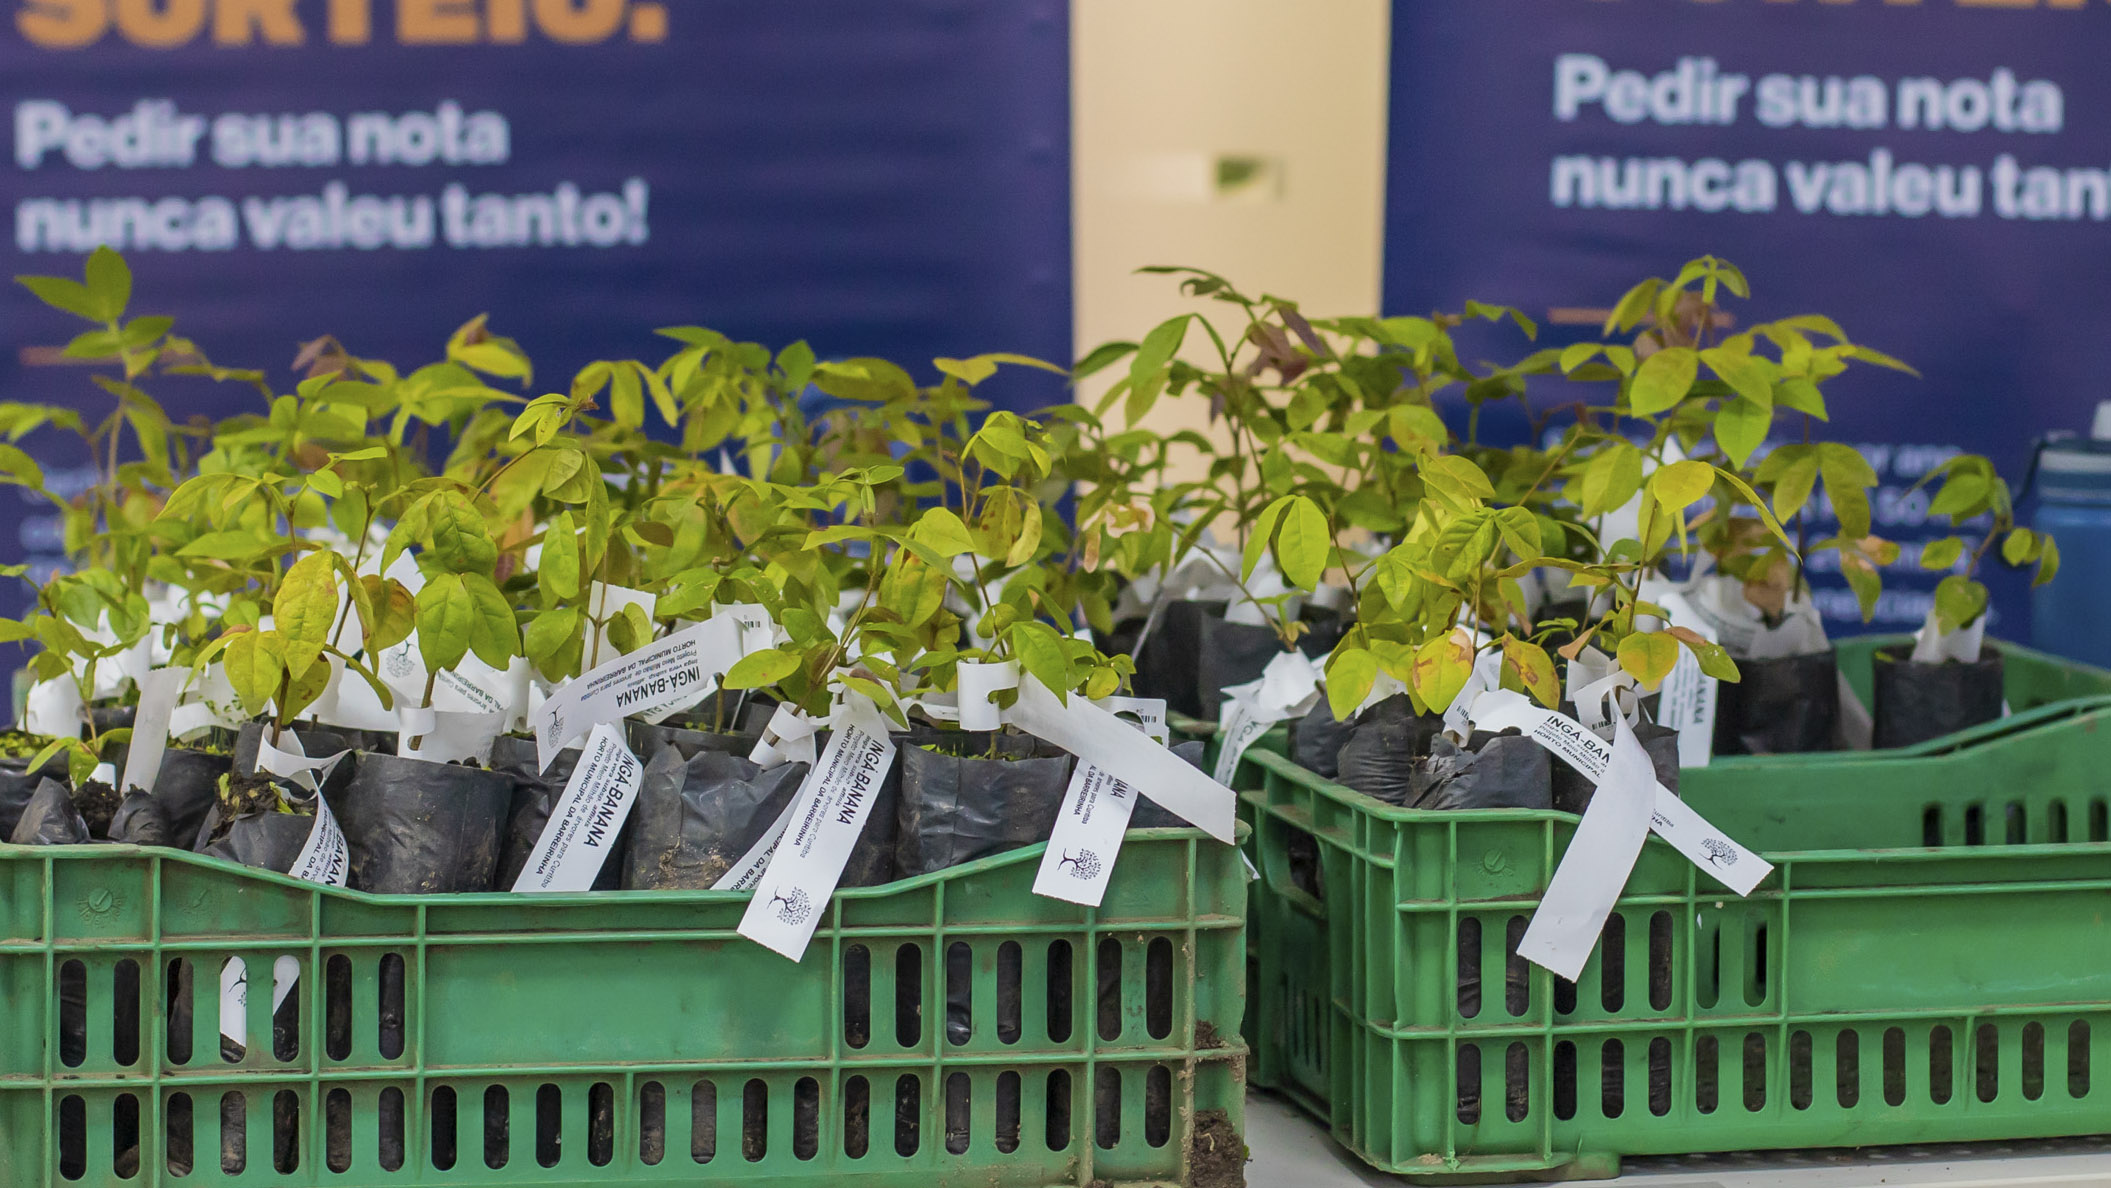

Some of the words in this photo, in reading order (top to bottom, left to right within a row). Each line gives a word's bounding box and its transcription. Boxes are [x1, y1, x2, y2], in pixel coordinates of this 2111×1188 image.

[1554, 53, 1749, 125] Pedir
[1756, 74, 1888, 130] sua
[1896, 67, 2064, 134] nota
[14, 99, 206, 168] Pedir
[212, 112, 340, 165] sua
[348, 100, 510, 165] nota
[1549, 155, 1777, 212] nunca
[1785, 147, 1982, 217] valeu
[15, 197, 239, 252] nunca
[243, 180, 434, 249] valeu
[442, 178, 649, 247] tanto!
[637, 648, 672, 666] MUNICIPAL
[672, 639, 696, 653] HORTO
[586, 666, 627, 690] BARREIRINHA
[627, 662, 637, 671] DA
[616, 665, 700, 708] INGÁ-BANANA
[593, 736, 609, 763] HORTO
[840, 723, 856, 749] HORTO
[1562, 739, 1578, 753] Meio
[822, 747, 844, 785] MUNICIPAL
[1533, 729, 1562, 747] HORTO
[1561, 746, 1601, 779] MUNICIPAL
[572, 762, 598, 804] MUNICIPAL
[596, 763, 609, 781] Meio
[836, 739, 886, 825] INGÁ-BANANA
[583, 752, 638, 848] INGÁ-BANANA
[584, 780, 601, 804] Milhão
[817, 786, 827, 797] DA
[1073, 777, 1093, 815] BARREIRINHA
[565, 805, 577, 818] DA
[584, 804, 598, 828] affinis
[793, 797, 822, 846] BARREIRINHA
[565, 815, 584, 843] árvores
[535, 818, 570, 875] BARREIRINHA
[556, 841, 569, 860] para
[306, 855, 317, 869] DA
[753, 856, 766, 869] DA
